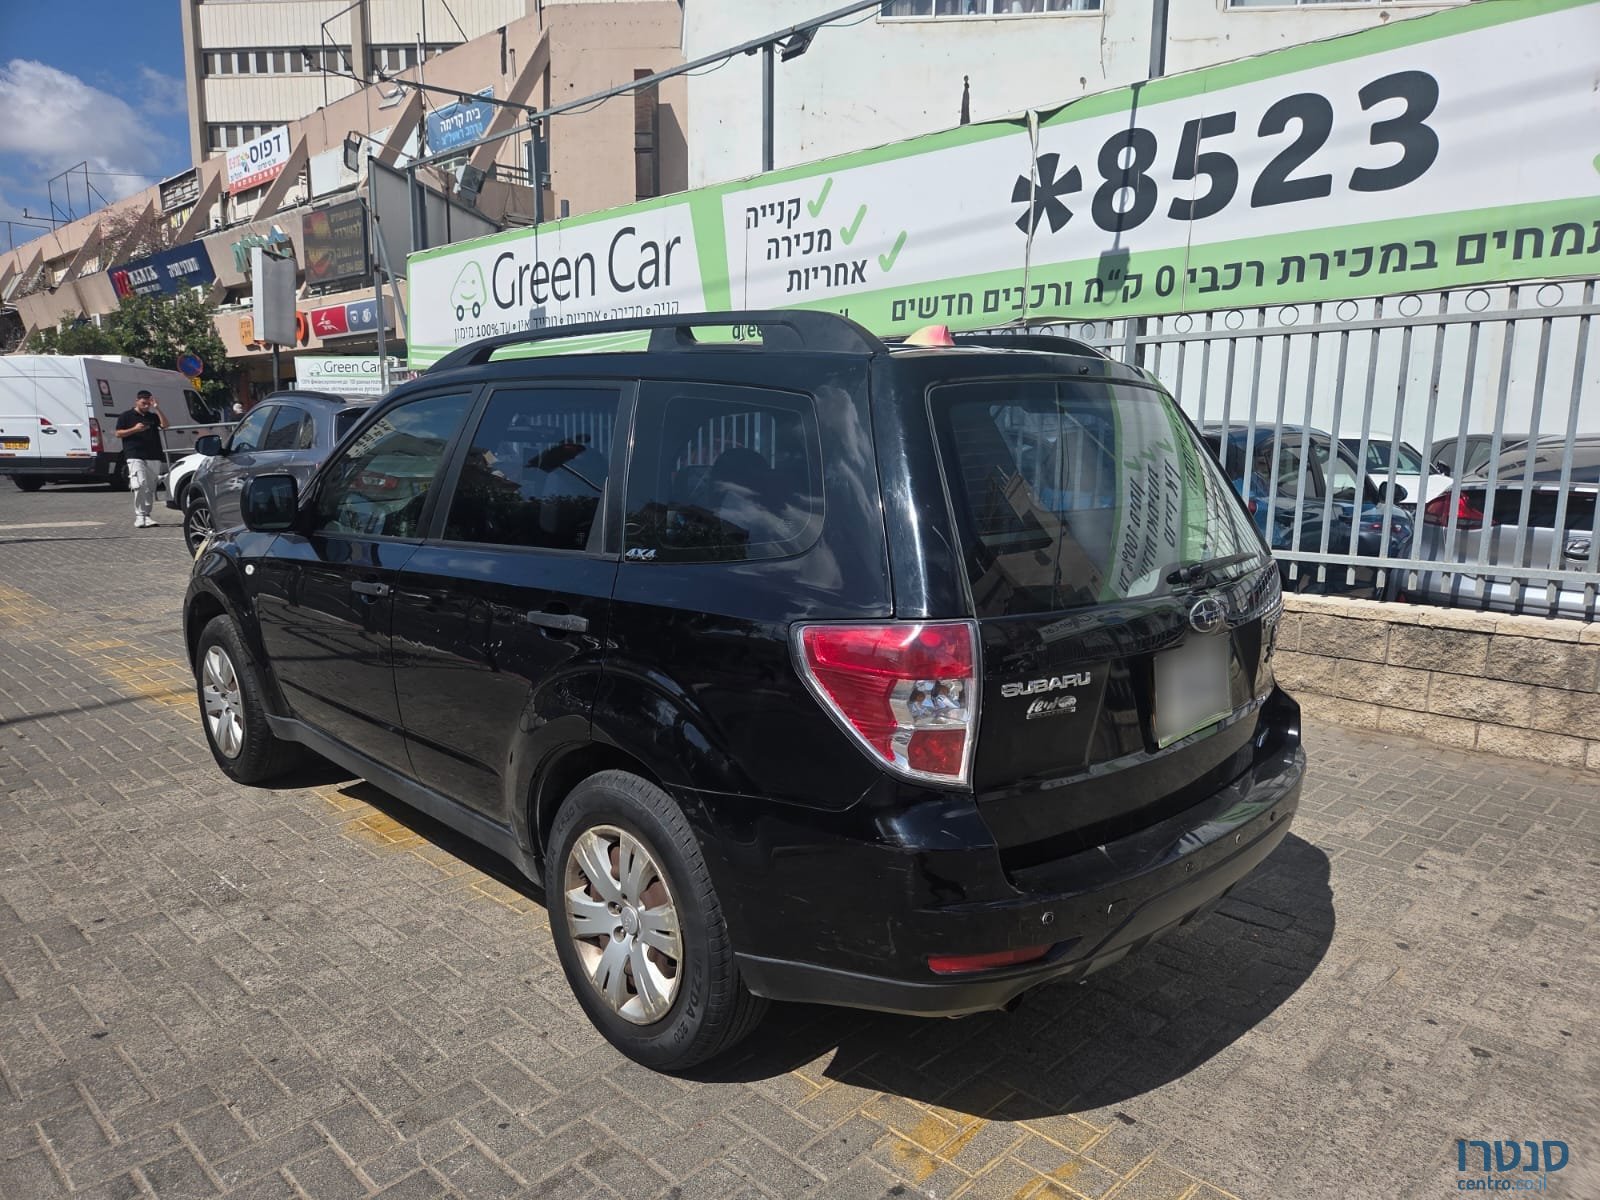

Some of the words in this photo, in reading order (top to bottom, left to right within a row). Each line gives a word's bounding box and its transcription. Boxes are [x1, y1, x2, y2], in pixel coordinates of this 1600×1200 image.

[249, 134, 281, 164] דפוס
[746, 197, 801, 230] קנייה
[767, 228, 832, 261] מכירה
[492, 251, 596, 310] Green
[608, 226, 682, 293] Car
[786, 259, 868, 293] אחריות
[1186, 260, 1265, 294] רכבי
[1276, 239, 1439, 286] במכירת
[982, 281, 1073, 313] ורכבים
[1155, 264, 1175, 298] 0
[891, 292, 973, 322] חדשים
[454, 326, 474, 344] מימון
[476, 323, 499, 337] 100%
[323, 360, 359, 373] Green
[361, 360, 381, 373] Car
[1001, 671, 1091, 698] SUBARU
